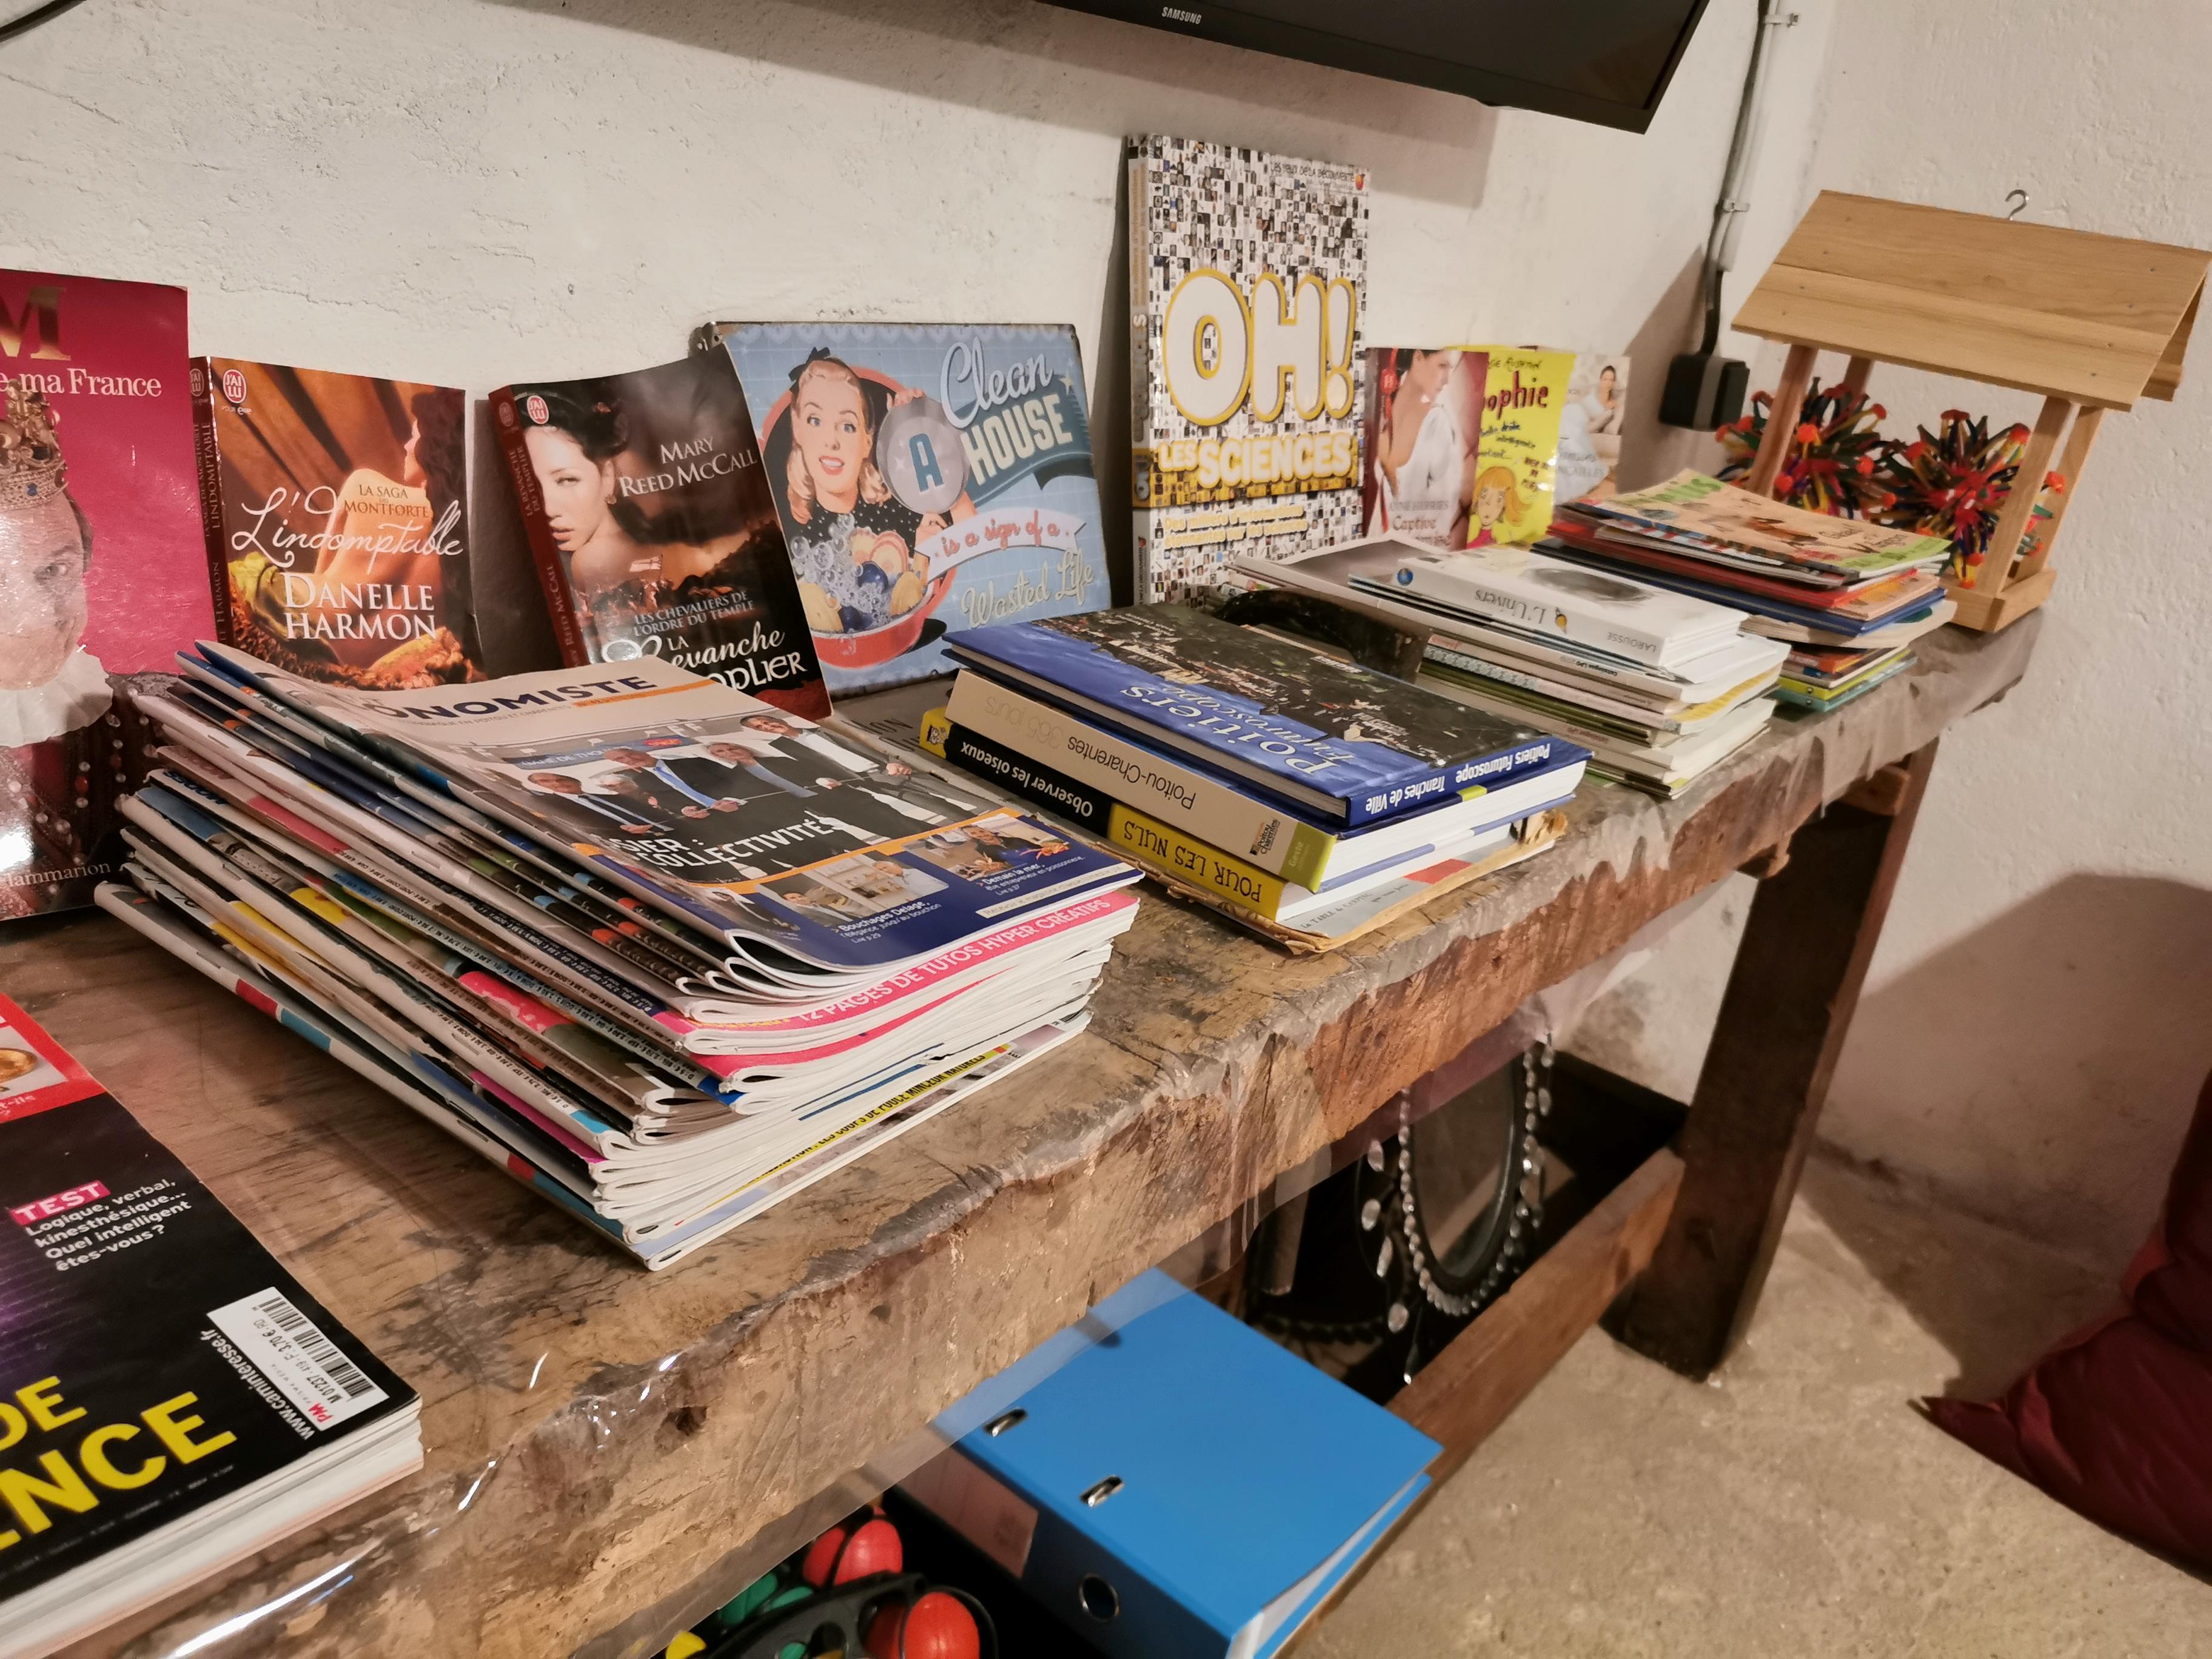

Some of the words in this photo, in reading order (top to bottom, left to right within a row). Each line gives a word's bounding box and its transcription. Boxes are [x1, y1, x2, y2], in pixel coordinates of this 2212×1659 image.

[1162, 7, 1202, 24] SAMSUNG
[1162, 268, 1356, 426] OH!
[19, 373, 64, 394] ma
[67, 367, 162, 397] France
[226, 374, 242, 386] J'AI
[227, 386, 242, 398] LU
[940, 337, 1054, 429] Clean
[1487, 370, 1548, 420] ophie
[660, 437, 714, 464] MARY
[961, 394, 1074, 486] HOUSE
[202, 423, 220, 528] L'INDOMPTABLE
[910, 433, 944, 492] A
[1158, 440, 1199, 472] LES
[1198, 432, 1352, 489] SCIENCES
[358, 483, 374, 496] LA
[377, 486, 408, 500] SAGA
[620, 473, 674, 498] REED
[344, 500, 429, 518] MONTFORTE
[942, 535, 960, 556] is
[965, 532, 979, 548] a
[984, 518, 1020, 550] sign
[1025, 510, 1041, 543] of
[1047, 525, 1060, 537] a
[283, 572, 435, 611] DANELLE
[961, 568, 1051, 629] Wasted
[1055, 547, 1094, 606] Life
[632, 619, 685, 637] L'ORDRE
[688, 612, 708, 626] DU
[710, 600, 755, 620] TEMPLE
[634, 612, 656, 625] LES
[657, 596, 729, 622] CHEVALIERS
[731, 591, 748, 602] DE
[284, 611, 436, 640] HARMON
[1607, 632, 1657, 653] LAROUSSE
[667, 635, 689, 651] LA
[1121, 684, 1341, 774] Poitiers
[1161, 685, 1356, 765] Futuroscope
[960, 740, 1010, 775] oiseaux
[1455, 753, 1513, 784] Futuroscope
[1515, 743, 1550, 767] Poitiers
[1012, 764, 1031, 789] les
[1067, 736, 1196, 810] Poitou-Charentes
[1404, 774, 1445, 802] Tranches
[1034, 776, 1093, 818] Observer
[1365, 793, 1387, 815] Ville
[1389, 789, 1403, 805] de
[637, 819, 834, 867] COLLECTIVITÉ
[1124, 820, 1168, 857] NULS
[1257, 823, 1271, 847] Poitou
[1260, 819, 1278, 854] Charentes
[1, 863, 111, 888] lammarion
[1175, 846, 1207, 877] LES
[1214, 871, 1262, 903] POUR
[838, 911, 894, 932] Bouchages
[797, 1005, 823, 1023] 12
[823, 984, 894, 1016] PAGES
[894, 968, 922, 990] DE
[919, 947, 983, 979] TUTOS
[982, 925, 1035, 954] HYPER
[1036, 897, 1111, 933] CRÉATIFS
[16, 1182, 102, 1222] TEST
[25, 1201, 110, 1236] Logique,
[112, 1178, 177, 1206] verbal,
[34, 1190, 187, 1249] kinesthésique...
[44, 1236, 93, 1261] Quel
[93, 1199, 192, 1249] intelligent
[269, 1335, 292, 1352] 3,70
[199, 1329, 315, 1441] www.caminteresse.fr
[306, 1374, 335, 1396] 01237
[308, 1402, 335, 1423] PM
[0, 1391, 238, 1550] NCE
